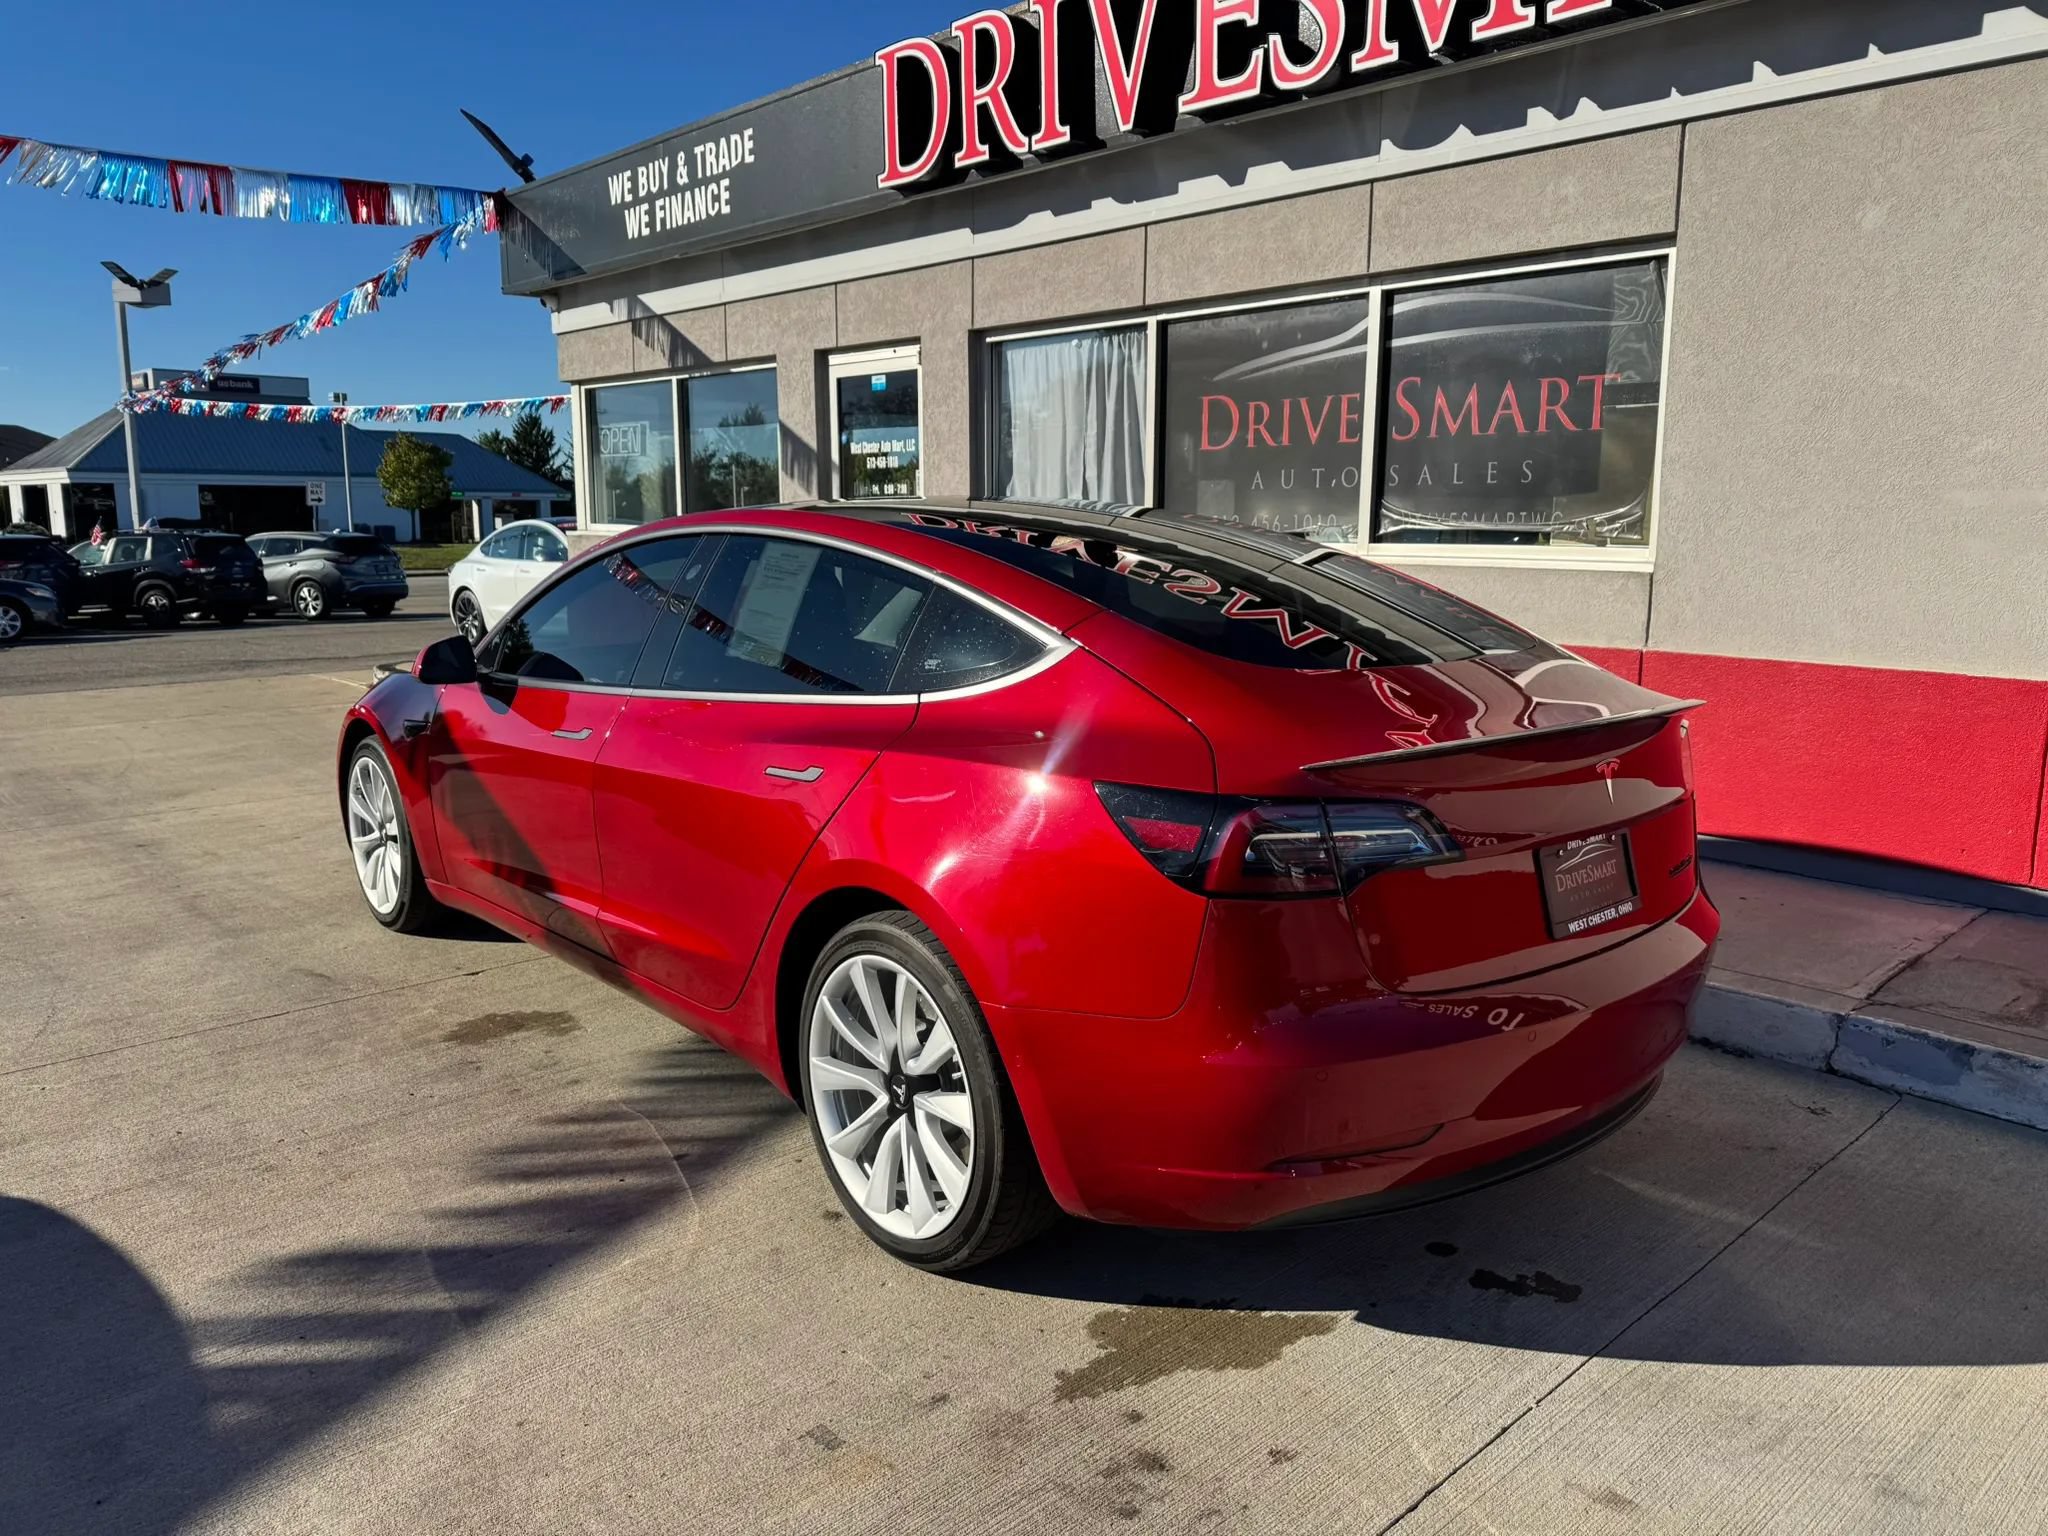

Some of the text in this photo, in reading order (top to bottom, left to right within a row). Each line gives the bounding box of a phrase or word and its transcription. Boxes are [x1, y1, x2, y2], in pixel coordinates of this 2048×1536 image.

[874, 0, 1612, 189] DRIVES
[608, 127, 755, 206] WE BUY & TRADE
[624, 178, 731, 240] WE FINANCE
[600, 427, 640, 454] OPEN
[1200, 373, 1622, 451] DRIVE SMART
[1251, 460, 1534, 490] AUTO SALES
[1567, 918, 1588, 933] WEST
[1588, 908, 1619, 926] CHESTER,
[1618, 902, 1633, 915] OHIO
